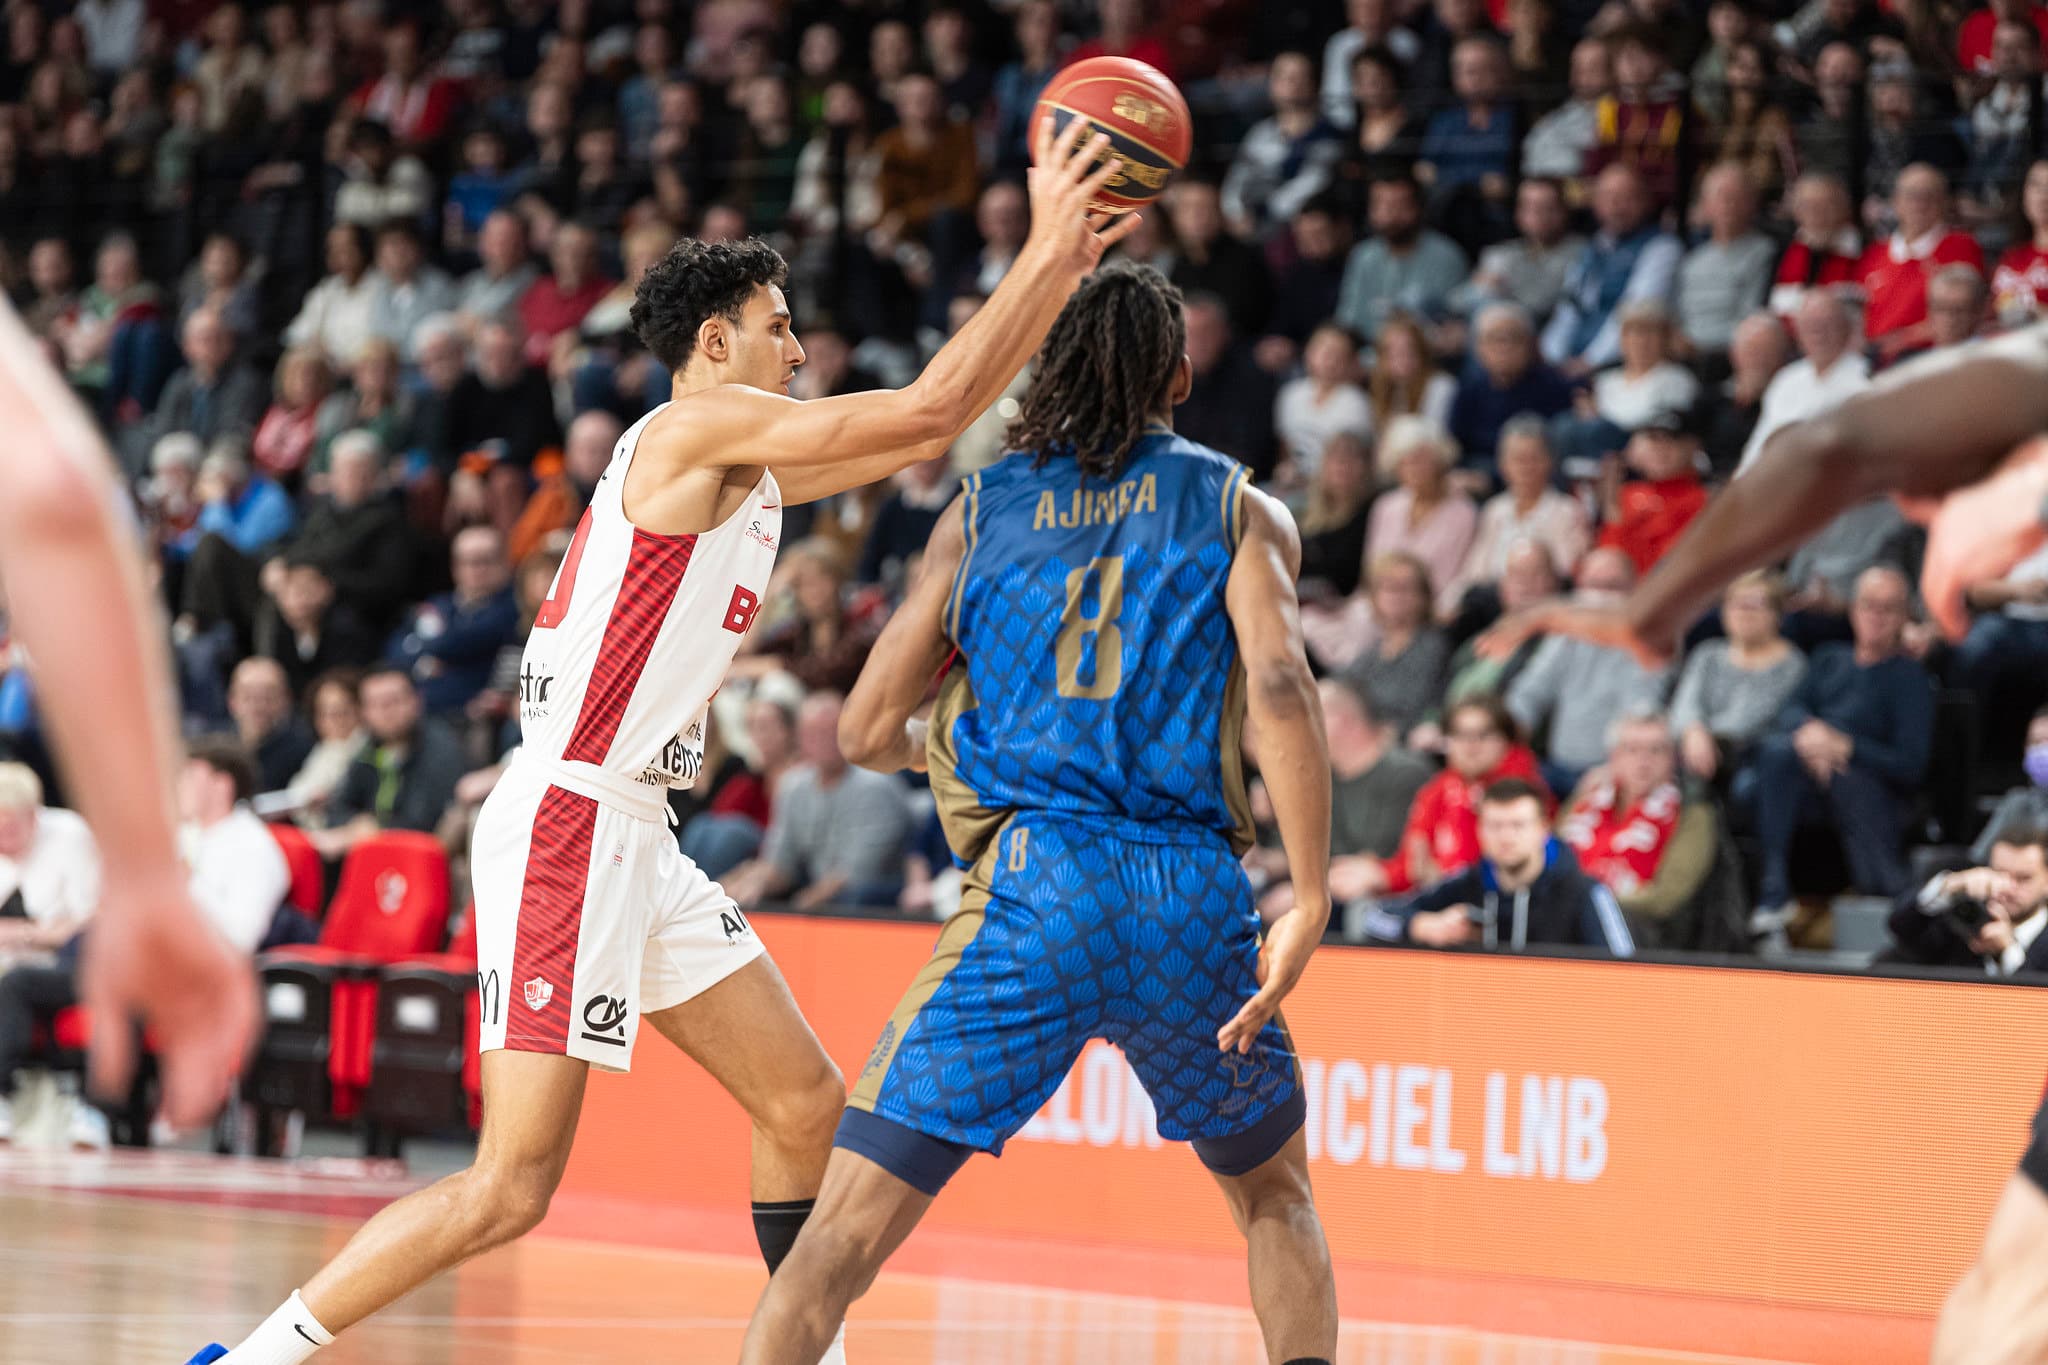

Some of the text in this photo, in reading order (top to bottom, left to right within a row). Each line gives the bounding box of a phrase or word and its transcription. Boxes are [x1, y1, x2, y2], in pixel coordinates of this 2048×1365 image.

[722, 584, 761, 634] B
[1056, 556, 1123, 699] 8
[1008, 829, 1029, 872] 8
[1015, 1046, 1163, 1147] LON
[1483, 1073, 1608, 1182] LNB
